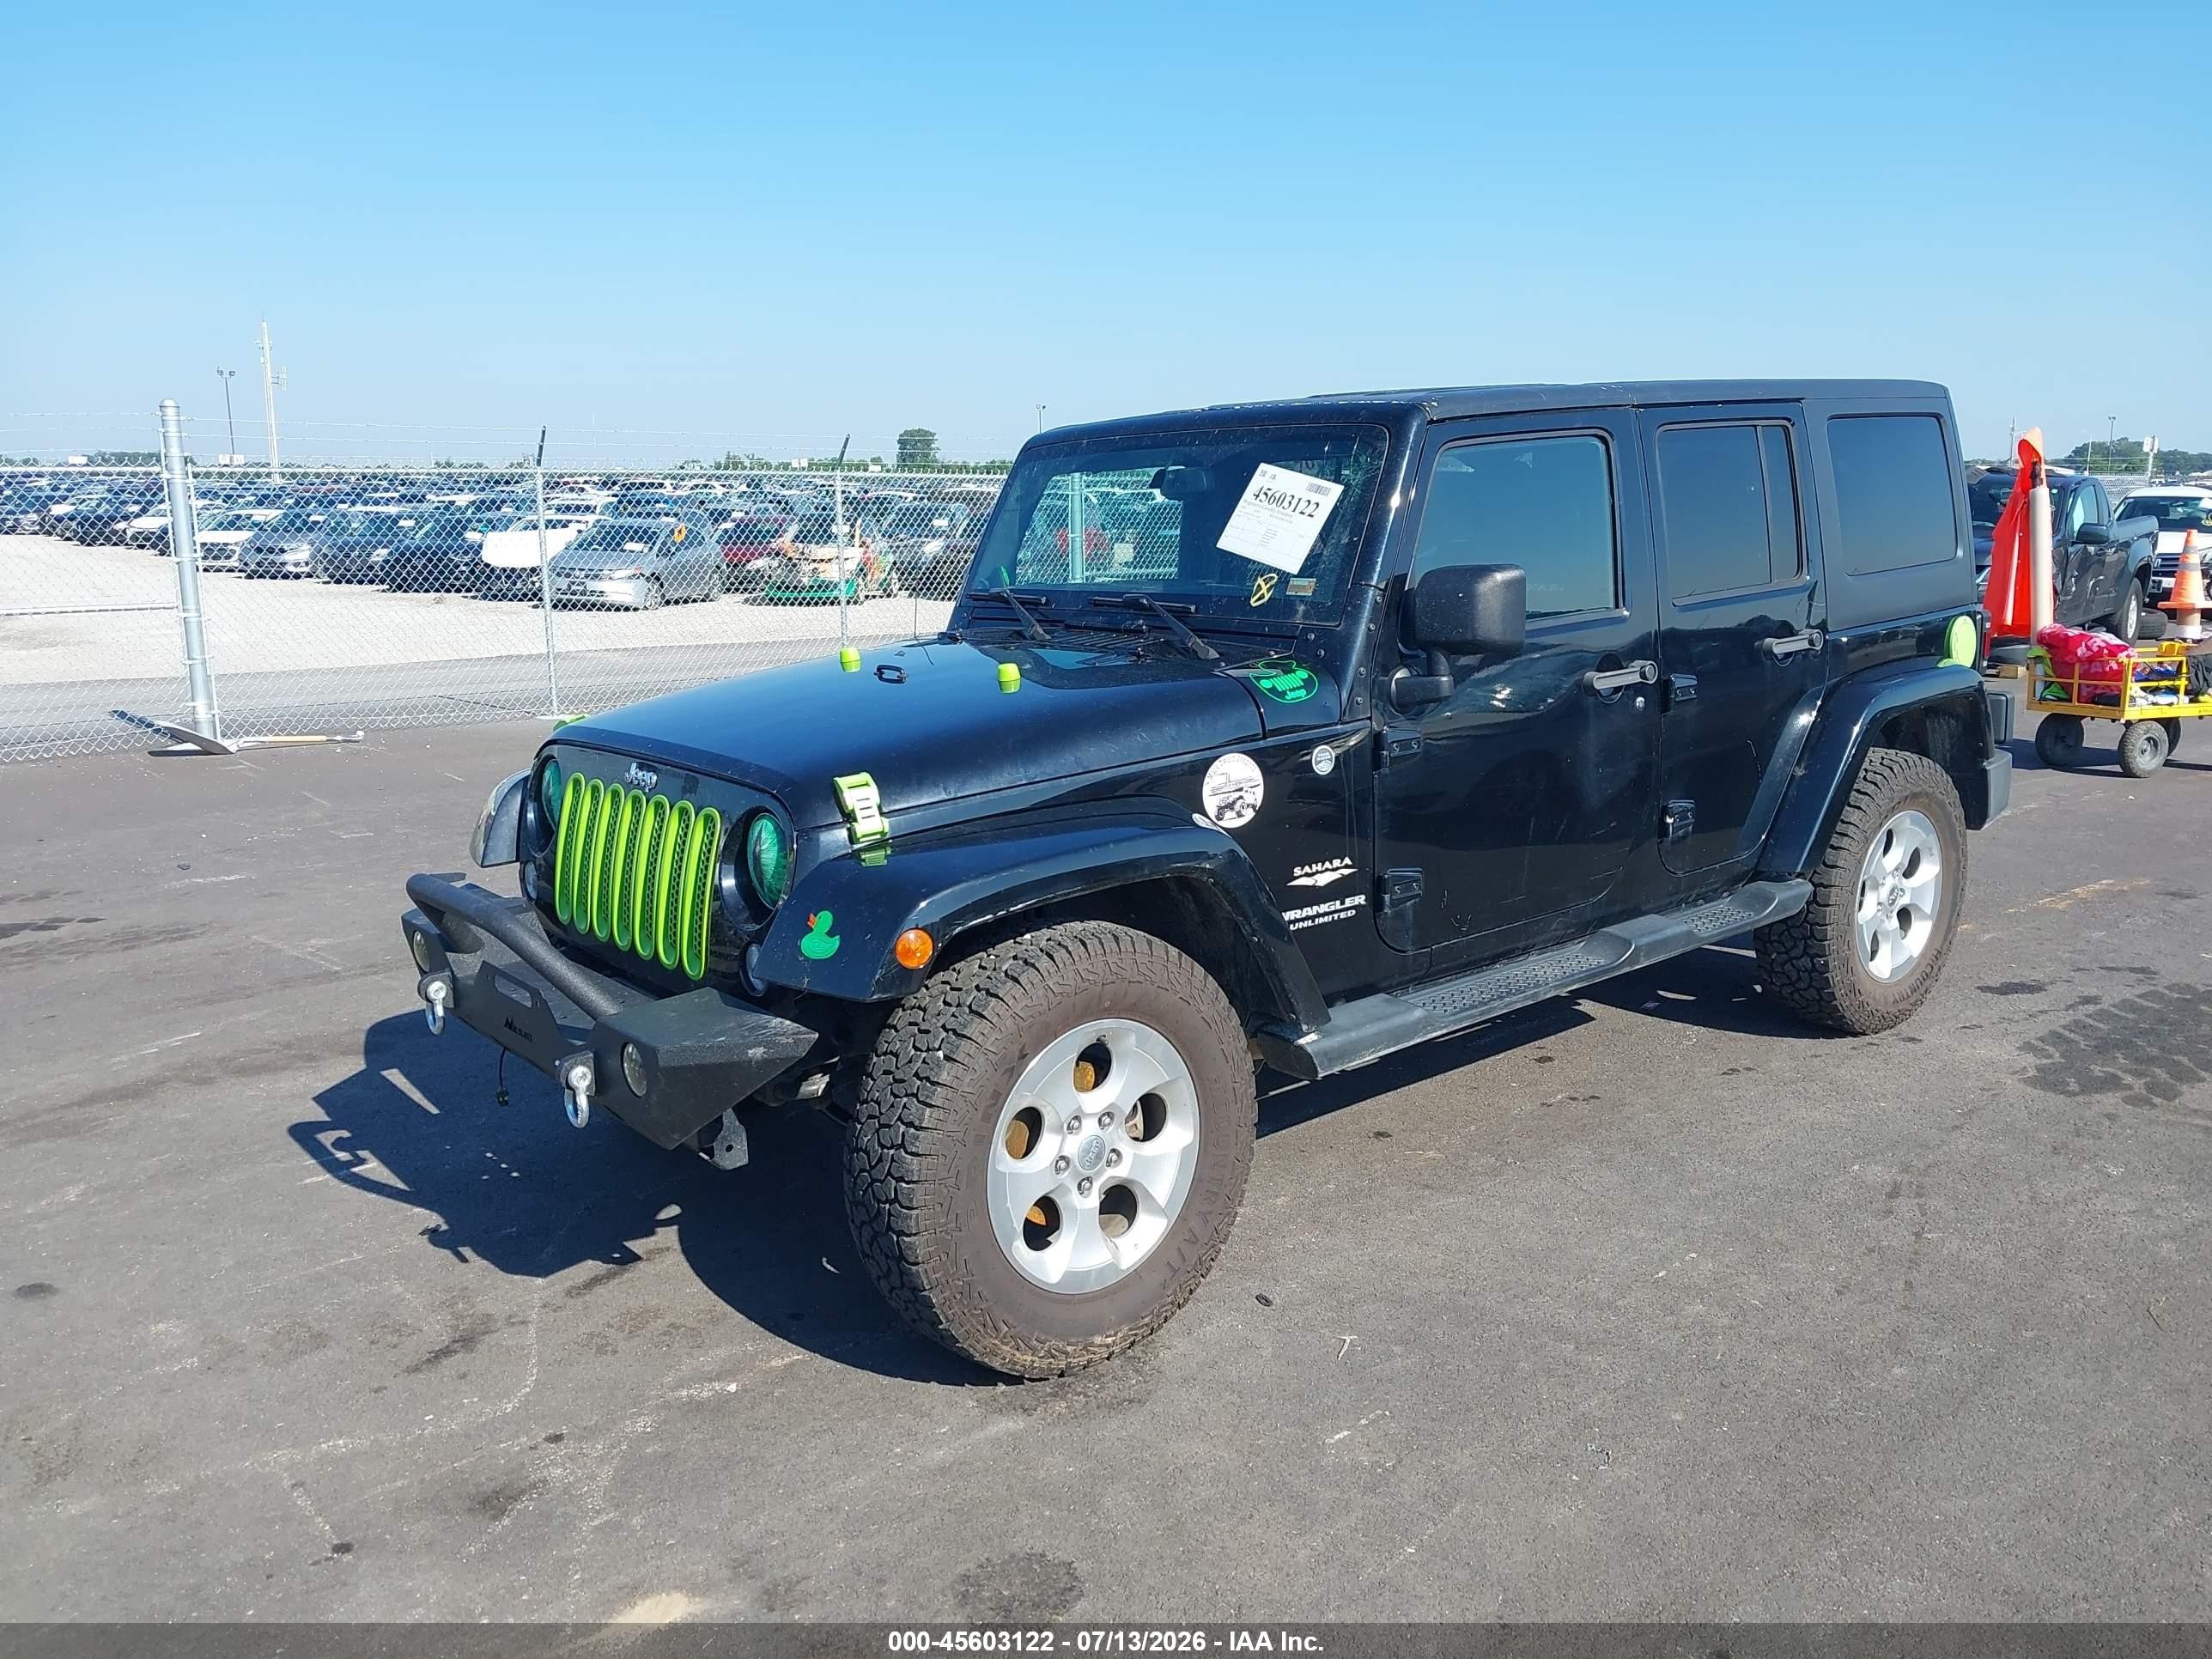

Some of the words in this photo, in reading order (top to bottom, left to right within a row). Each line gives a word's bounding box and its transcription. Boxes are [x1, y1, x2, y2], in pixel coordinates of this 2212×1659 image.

[1253, 485, 1320, 519] 45603122
[1285, 689, 1307, 700] Jeep
[624, 762, 659, 793] Jeep
[1292, 856, 1353, 877] SAHARA
[1289, 909, 1357, 931] UNLIMITED
[1085, 1139, 1103, 1168] Jeep
